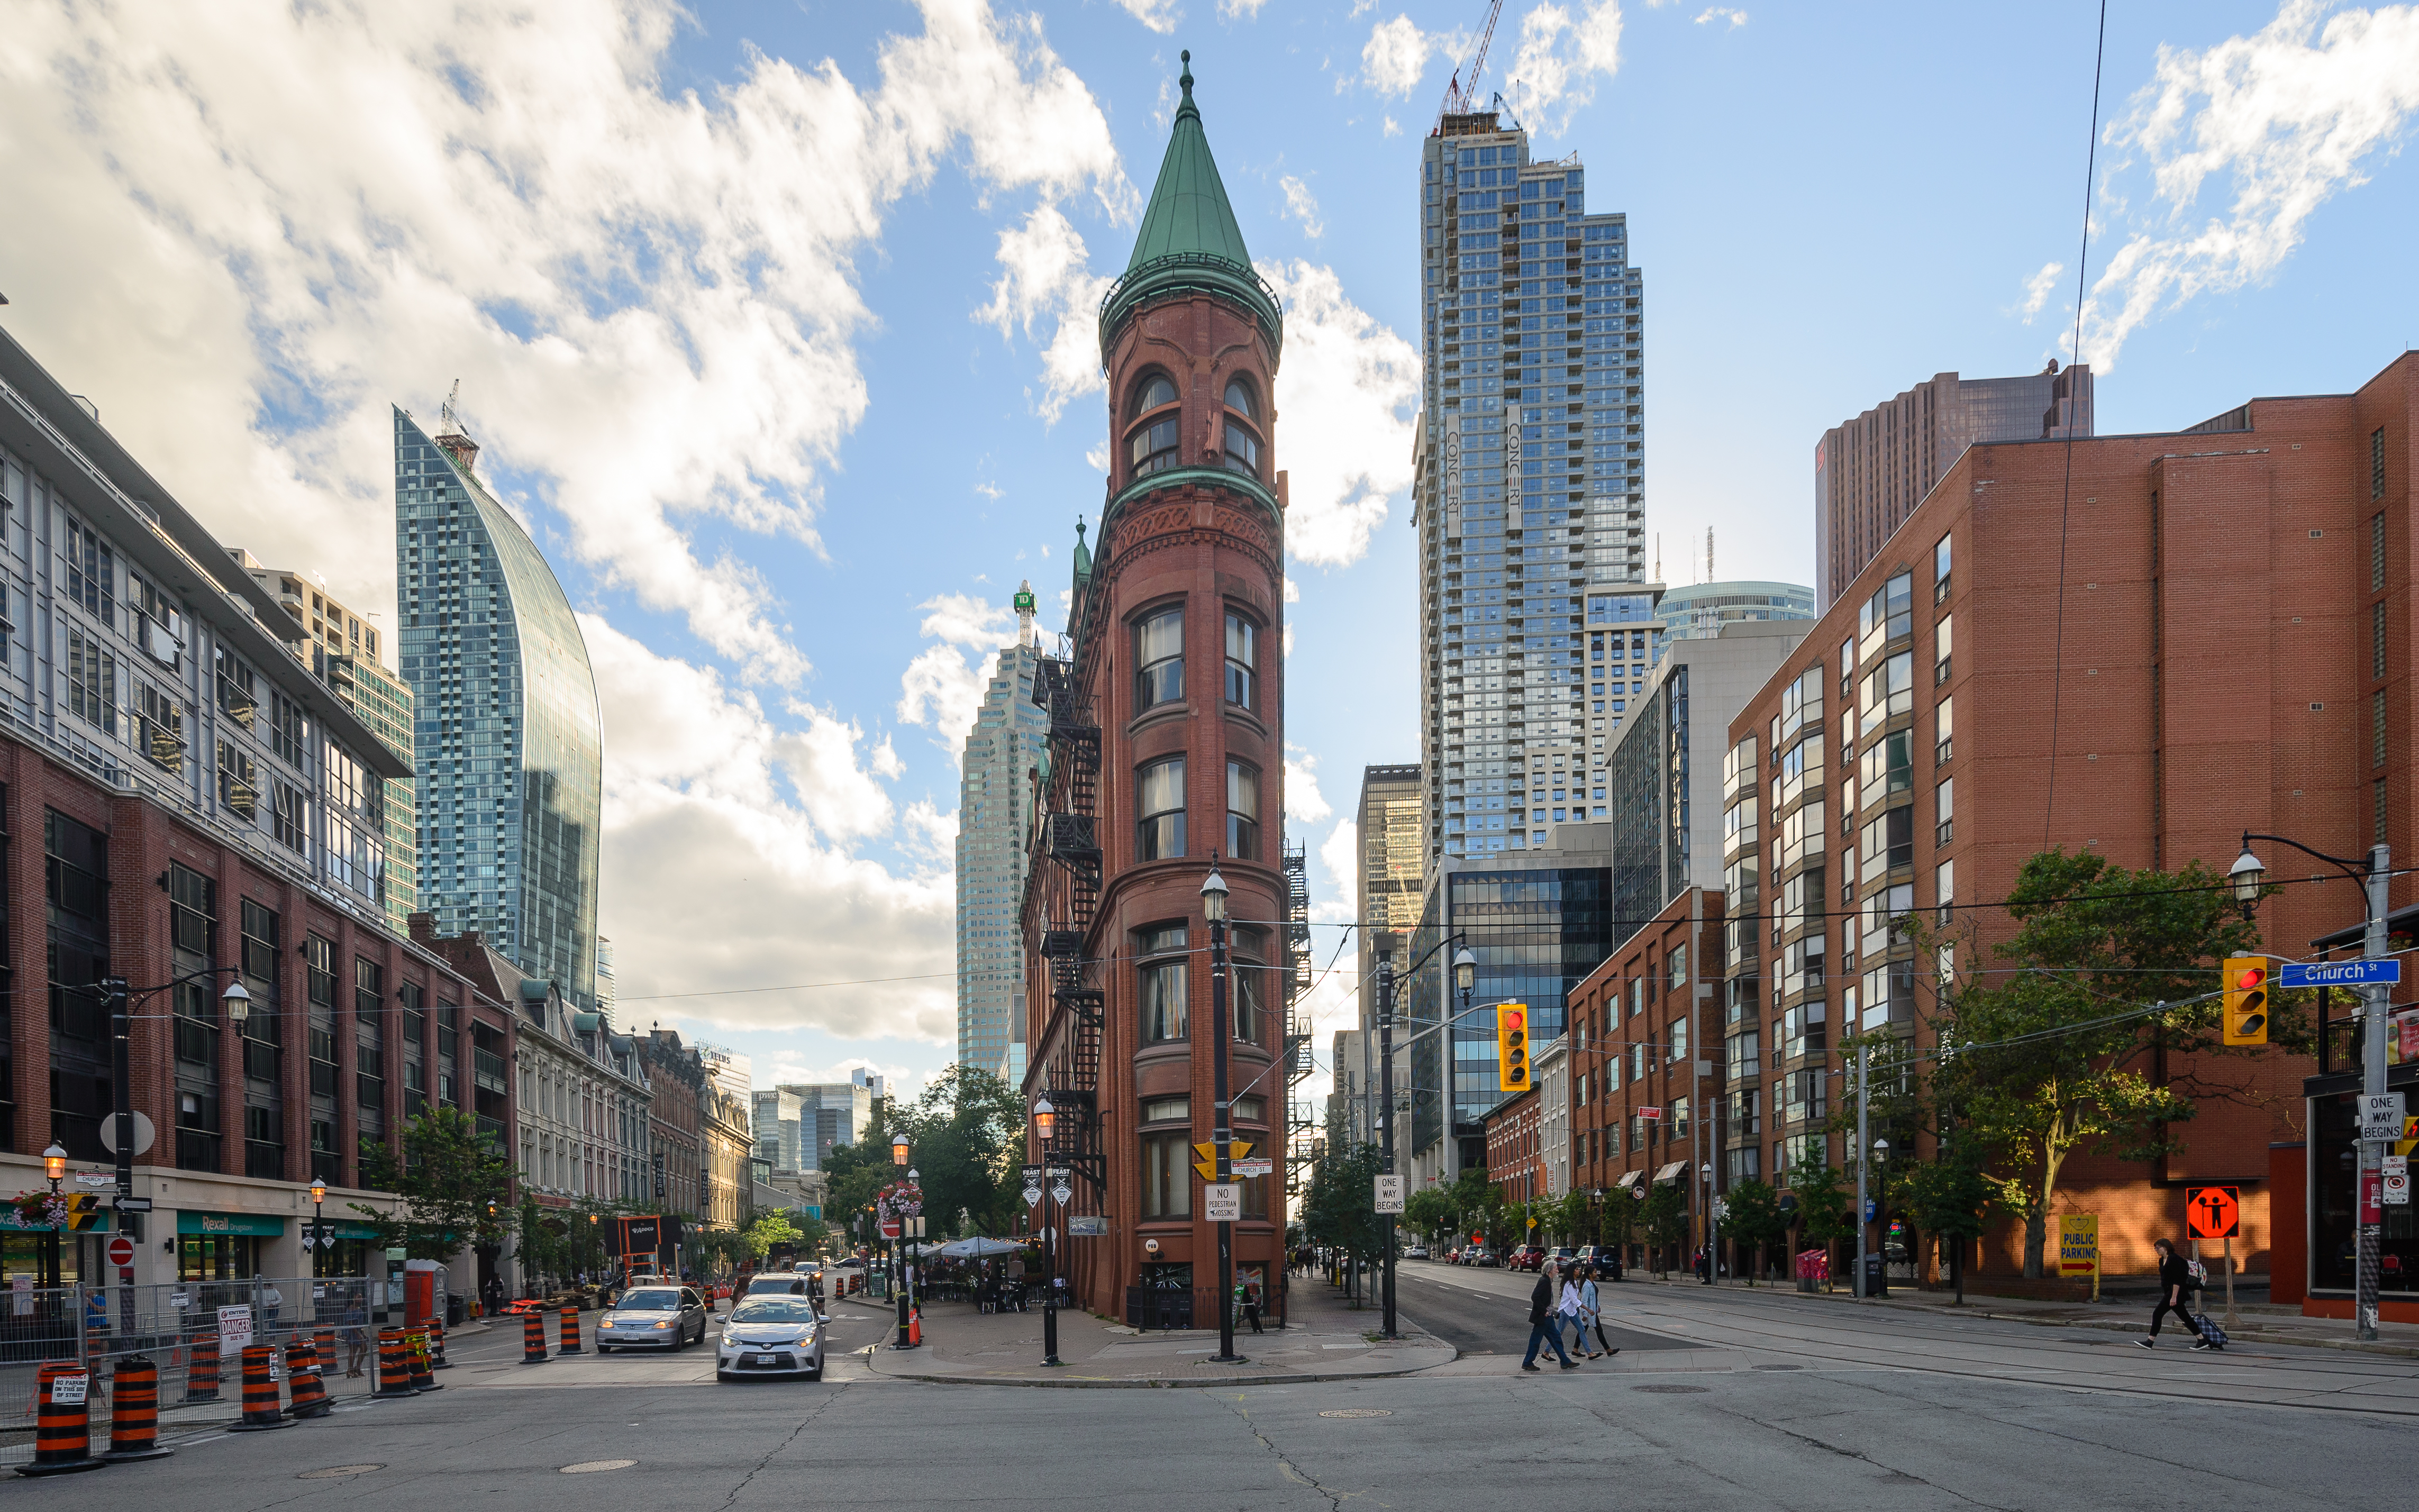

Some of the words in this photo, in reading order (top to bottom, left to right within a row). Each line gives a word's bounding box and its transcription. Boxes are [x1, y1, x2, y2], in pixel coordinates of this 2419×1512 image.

[1508, 423, 1521, 509] CONCERT
[1447, 431, 1459, 517] CONCERT
[1017, 595, 1029, 604] TD
[2305, 963, 2365, 981] Church
[2369, 963, 2378, 971] St
[710, 1051, 731, 1064] TELUS
[758, 1092, 777, 1101] pwc
[2370, 1097, 2394, 1109] ONE
[2372, 1112, 2394, 1123] WAY
[2364, 1126, 2400, 1138] BEGINS
[1382, 1178, 1397, 1187] ONE
[1217, 1188, 1229, 1199] NO
[1382, 1189, 1397, 1198] WAY
[1377, 1200, 1403, 1210] BEGINS
[202, 1216, 229, 1232] Rexall
[230, 1223, 253, 1232] Drugstore
[2064, 1233, 2094, 1245] PUBLIC
[2061, 1247, 2097, 1259] PARKING
[221, 1319, 251, 1334] DANGER
